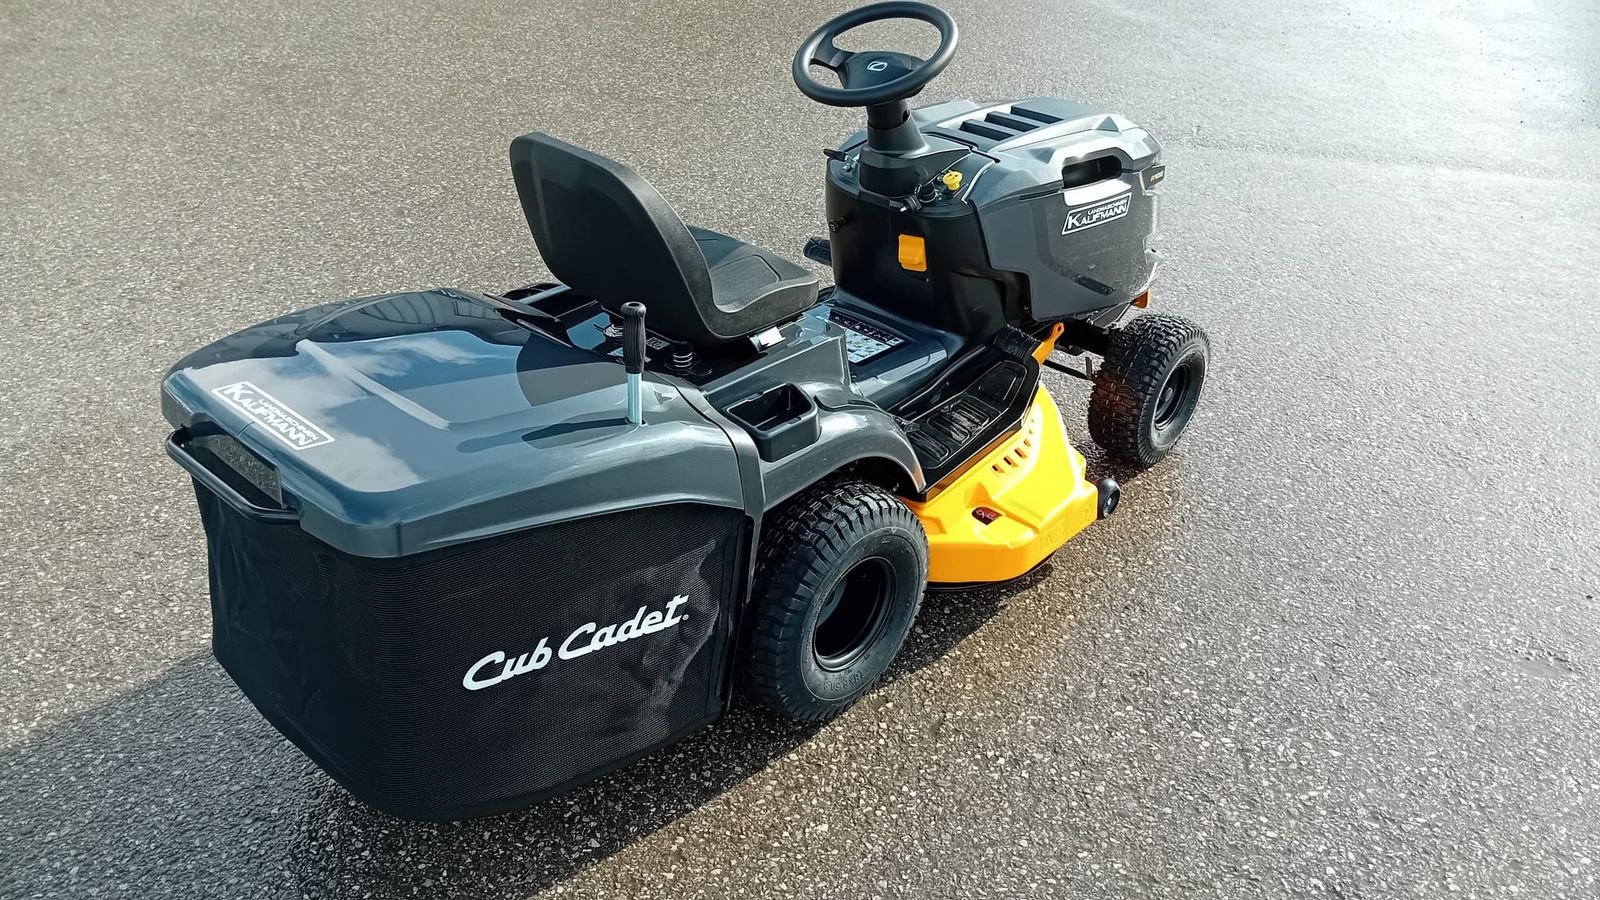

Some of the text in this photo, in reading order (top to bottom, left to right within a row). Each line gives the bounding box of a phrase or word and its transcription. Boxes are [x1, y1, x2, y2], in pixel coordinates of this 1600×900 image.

[1067, 203, 1127, 230] KAUFMANN
[223, 384, 313, 446] KAUFMANN
[462, 594, 690, 691] Cub Cadet
